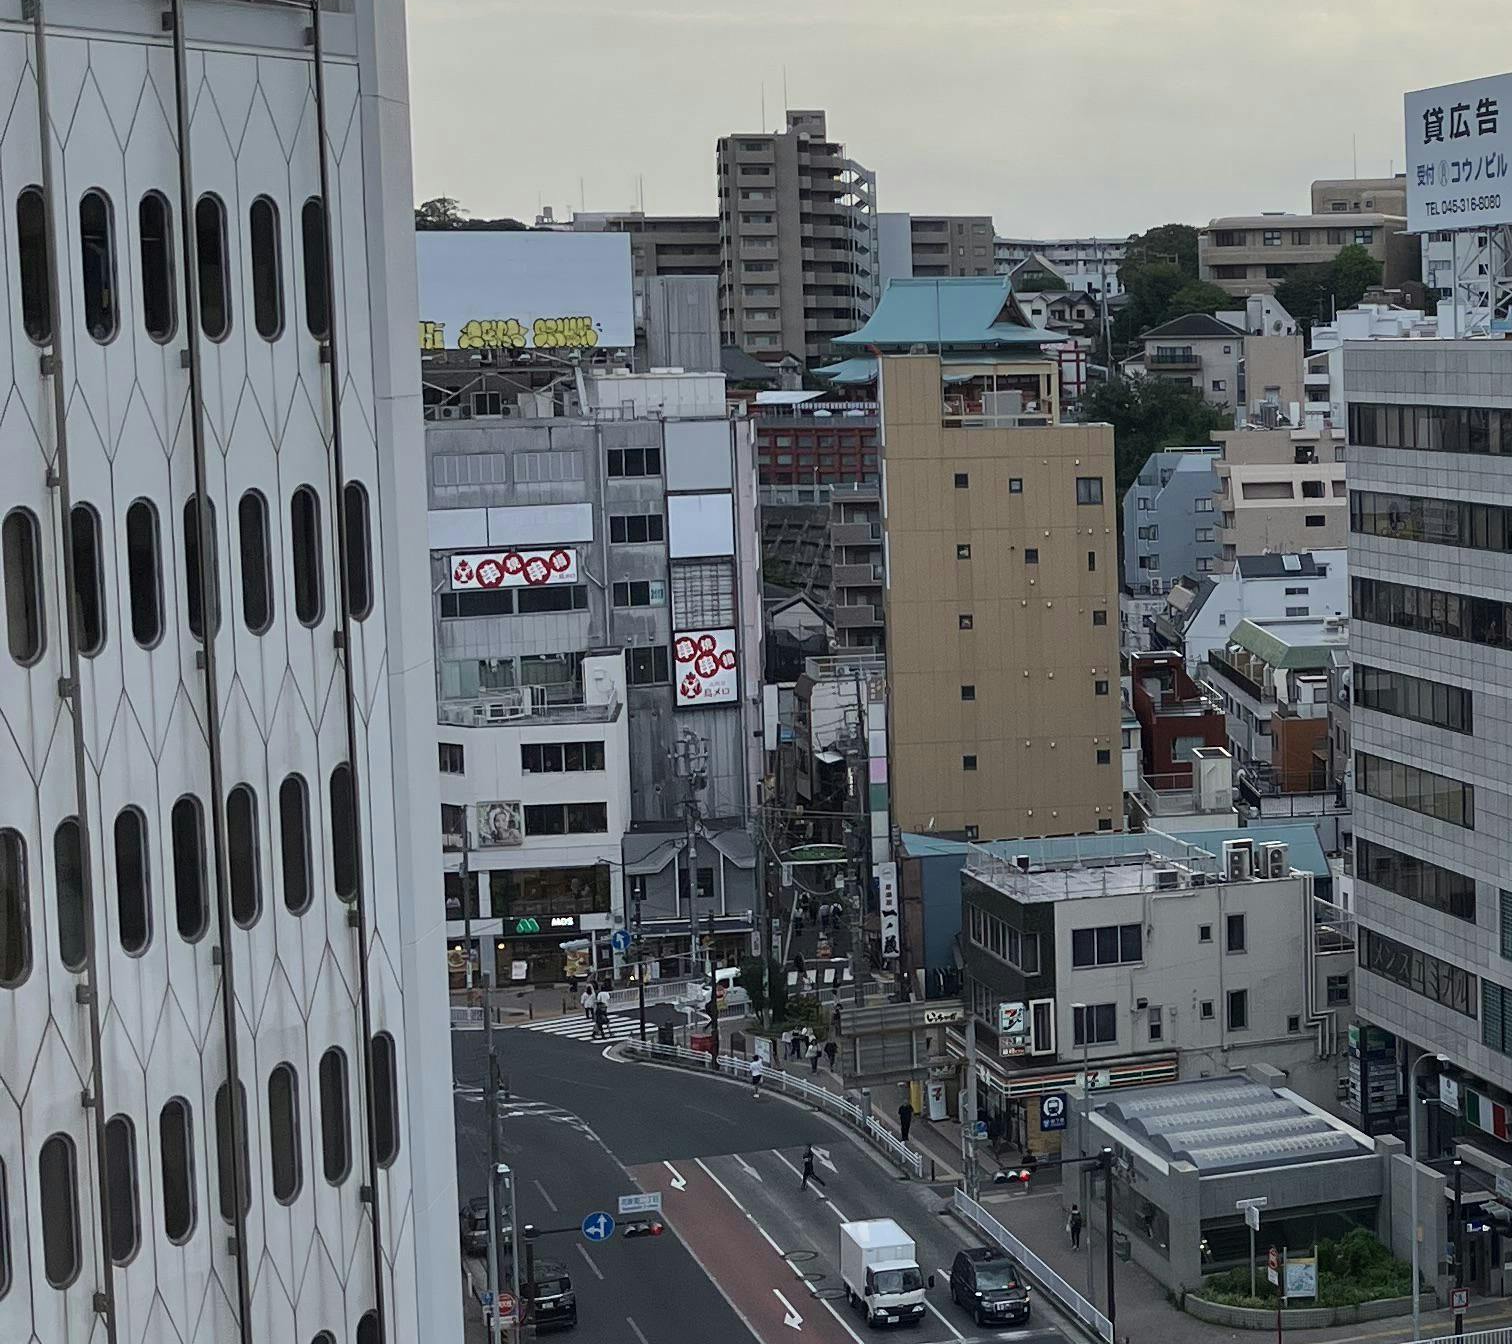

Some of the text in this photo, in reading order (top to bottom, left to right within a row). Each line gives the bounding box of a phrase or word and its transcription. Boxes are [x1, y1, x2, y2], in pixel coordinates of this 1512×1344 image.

[1422, 97, 1499, 145] 貸広告
[1416, 151, 1508, 187] 受付 コウノビル
[1425, 194, 1501, 216] TEL 045-316-8080
